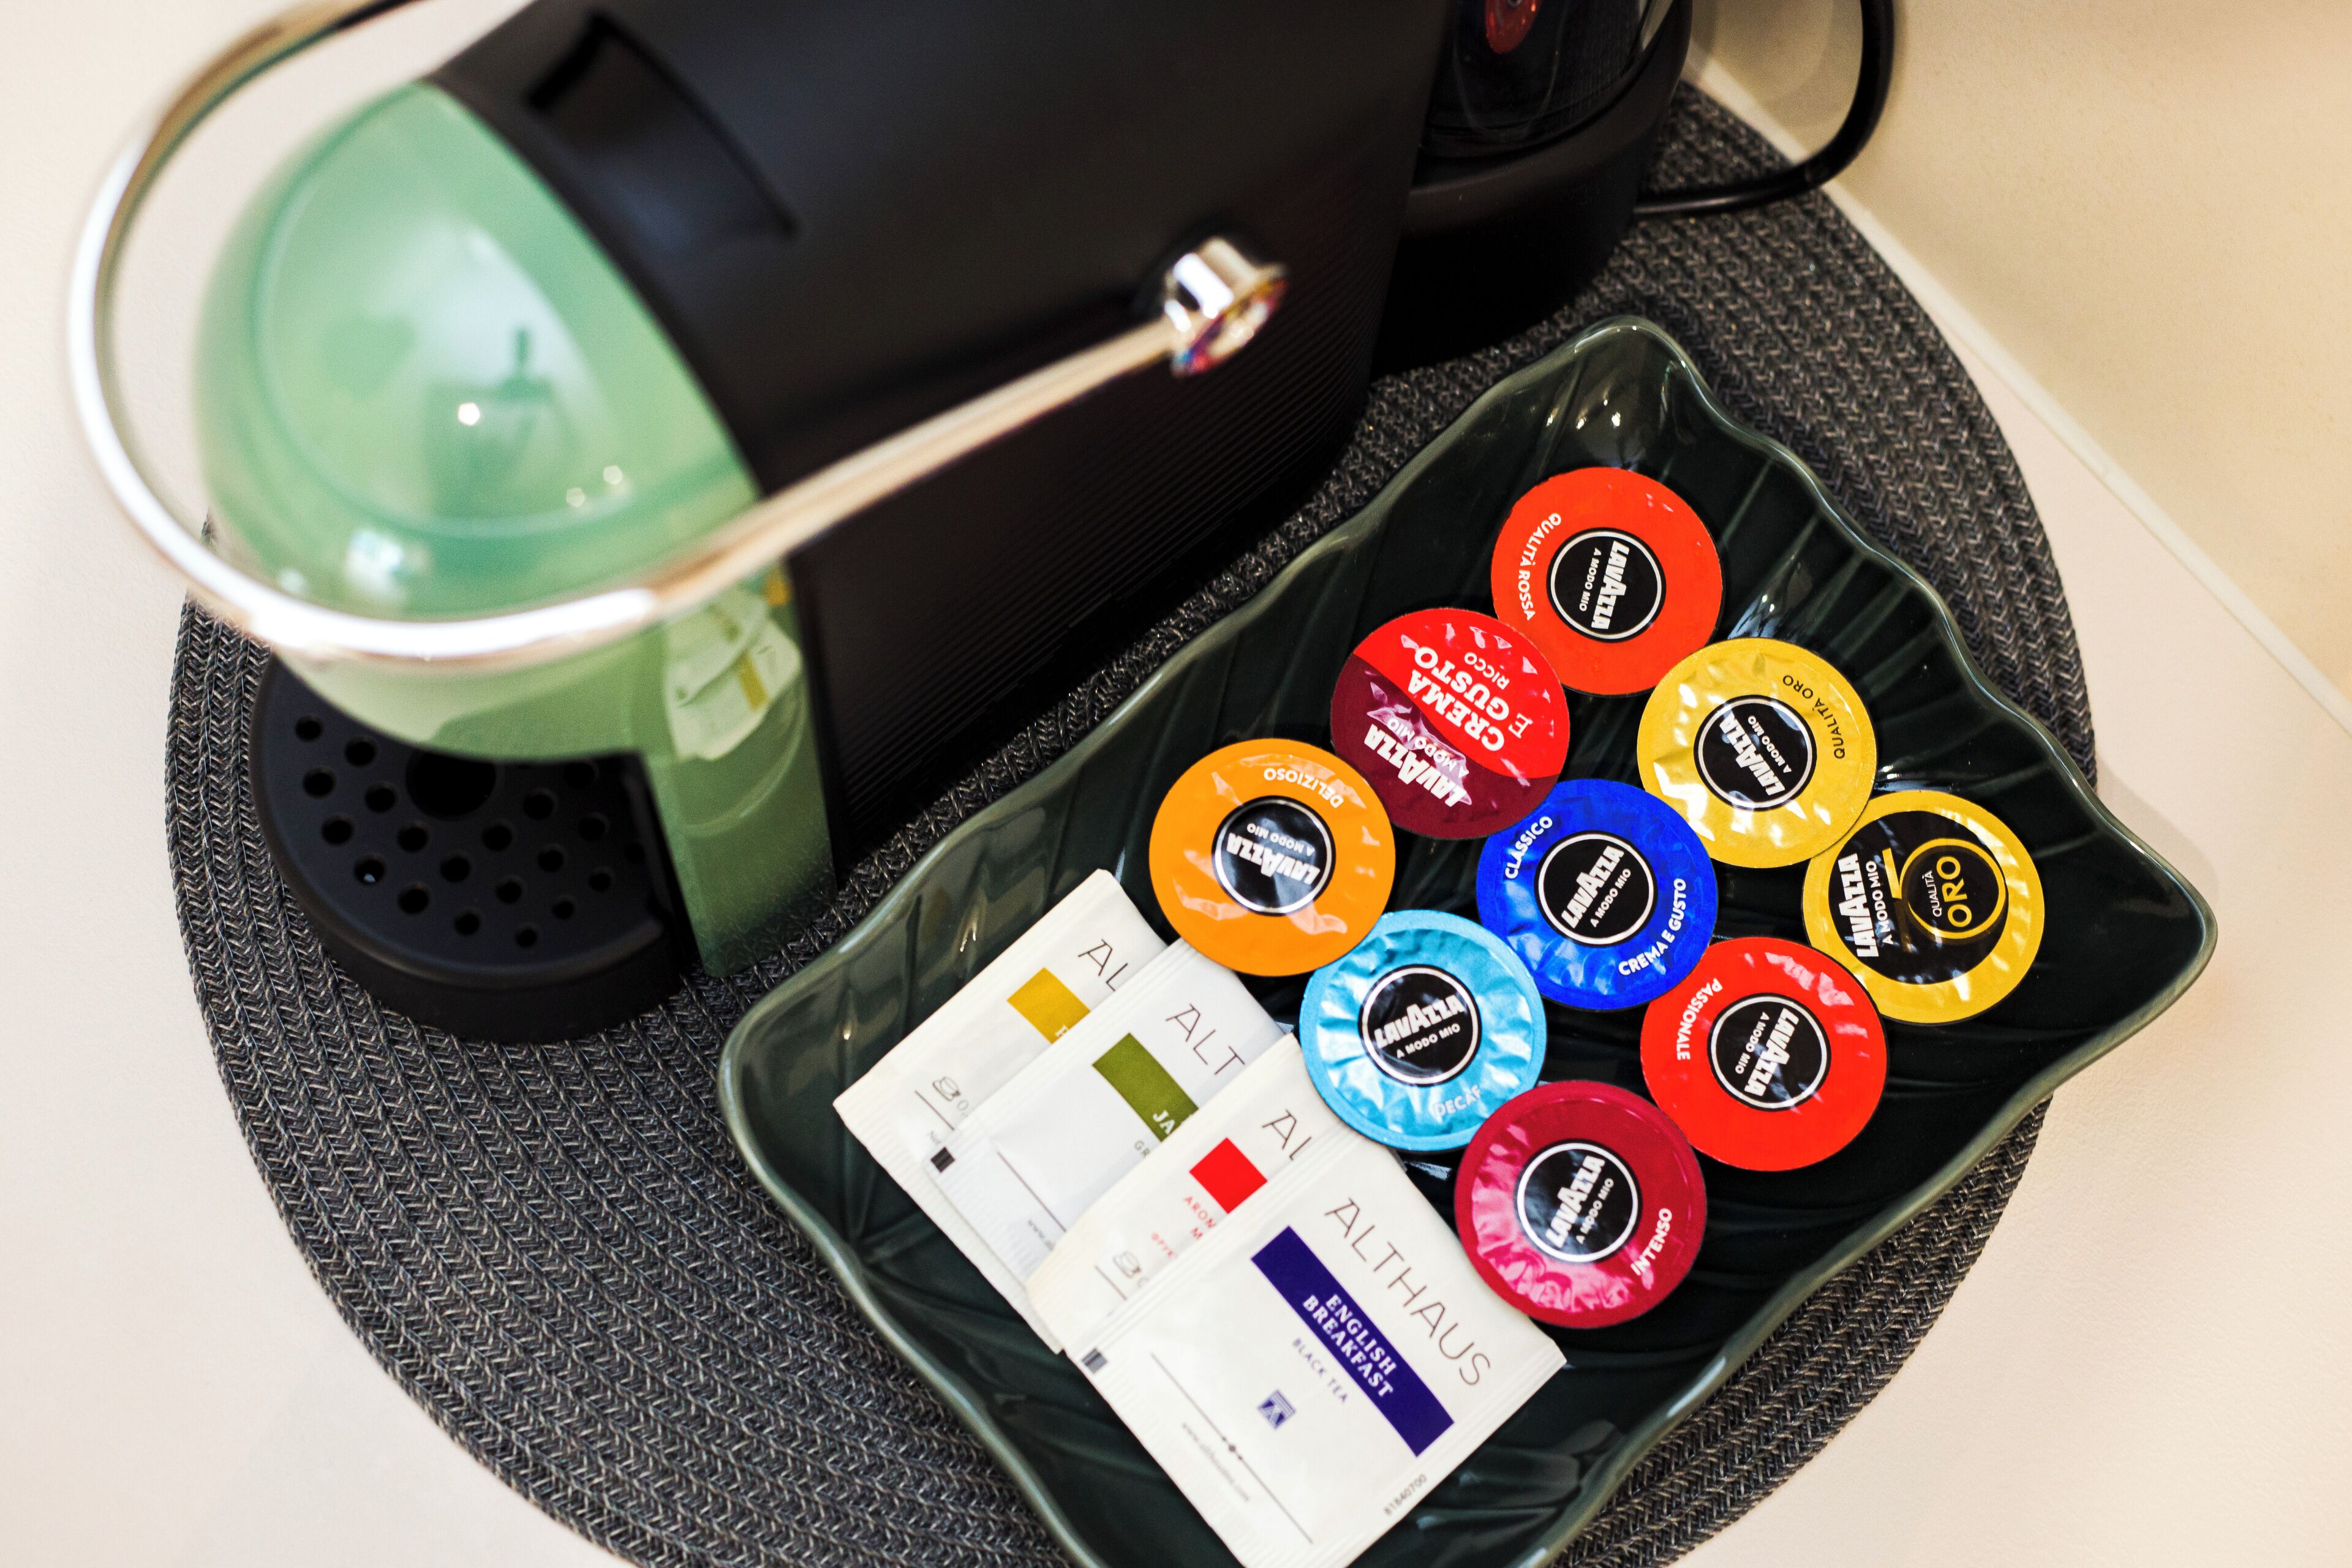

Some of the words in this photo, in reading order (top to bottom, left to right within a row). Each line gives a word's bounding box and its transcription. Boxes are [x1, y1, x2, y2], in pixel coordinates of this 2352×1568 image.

[1520, 513, 1561, 567] QUALITÀ
[1594, 548, 1601, 556] A
[1518, 571, 1536, 620] ROSSA
[1585, 557, 1600, 590] MODO
[1591, 541, 1629, 630] LAVAZZA
[1579, 591, 1591, 612] MIO
[1414, 647, 1509, 720] GUSTO
[1464, 652, 1510, 690] RICCO
[1782, 675, 1814, 699] ORO
[1387, 718, 1415, 742] MIO
[1408, 669, 1504, 751] CREMA
[1748, 715, 1767, 736] MIO
[1812, 698, 1845, 760] QUALITÀ
[1363, 724, 1462, 807] LAVAZZA
[1415, 736, 1457, 772] MODO
[1457, 764, 1469, 778] A
[1719, 713, 1785, 796] LAVAZZA
[1762, 736, 1786, 767] MODO
[1783, 765, 1792, 774] A
[1264, 768, 1344, 809] DELIZIOSO
[1246, 823, 1268, 840] MIO
[1270, 833, 1305, 853] MODO
[1305, 845, 1315, 857] A
[1505, 816, 1553, 879] CLASSICO
[1226, 832, 1321, 885] LAVAZZA
[1866, 861, 1880, 888] MIO
[1561, 845, 1625, 929] LAVAZZA
[1590, 918, 1599, 927] A
[1596, 888, 1619, 919] MODO
[1615, 869, 1632, 889] MIO
[1668, 878, 1687, 931] GUSTO
[1838, 853, 1879, 957] LAVAZZA
[1921, 870, 1942, 917] QUALITÀ
[1936, 856, 1972, 927] ORO
[1871, 891, 1889, 933] MODO
[1618, 941, 1668, 976] CREMA
[1661, 929, 1676, 944] E
[1882, 935, 1894, 945] A
[1374, 995, 1465, 1049] LAVAZZA
[1676, 978, 1723, 1061] PASSIONALE
[1746, 1022, 1765, 1053] MODO
[1760, 1012, 1770, 1020] A
[1396, 1049, 1405, 1059] A
[1406, 1034, 1438, 1055] MODO
[1439, 1023, 1461, 1039] MIO
[1735, 1055, 1751, 1074] MIO
[1744, 1008, 1799, 1096] LAVAZZA
[1434, 1085, 1482, 1118] DECAF
[1545, 1156, 1605, 1248] LAVAZZA
[1575, 1235, 1585, 1244] A
[1580, 1200, 1602, 1236] MODO
[1600, 1178, 1614, 1200] MIO
[1630, 1208, 1673, 1276] INTENSO
[1324, 1197, 1491, 1385] ALTHAUS
[1302, 1295, 1393, 1398] BREAKFAST
[1325, 1294, 1397, 1376] ENGLISH
[1292, 1337, 1325, 1376] BLACK
[1327, 1378, 1348, 1403] TEA
